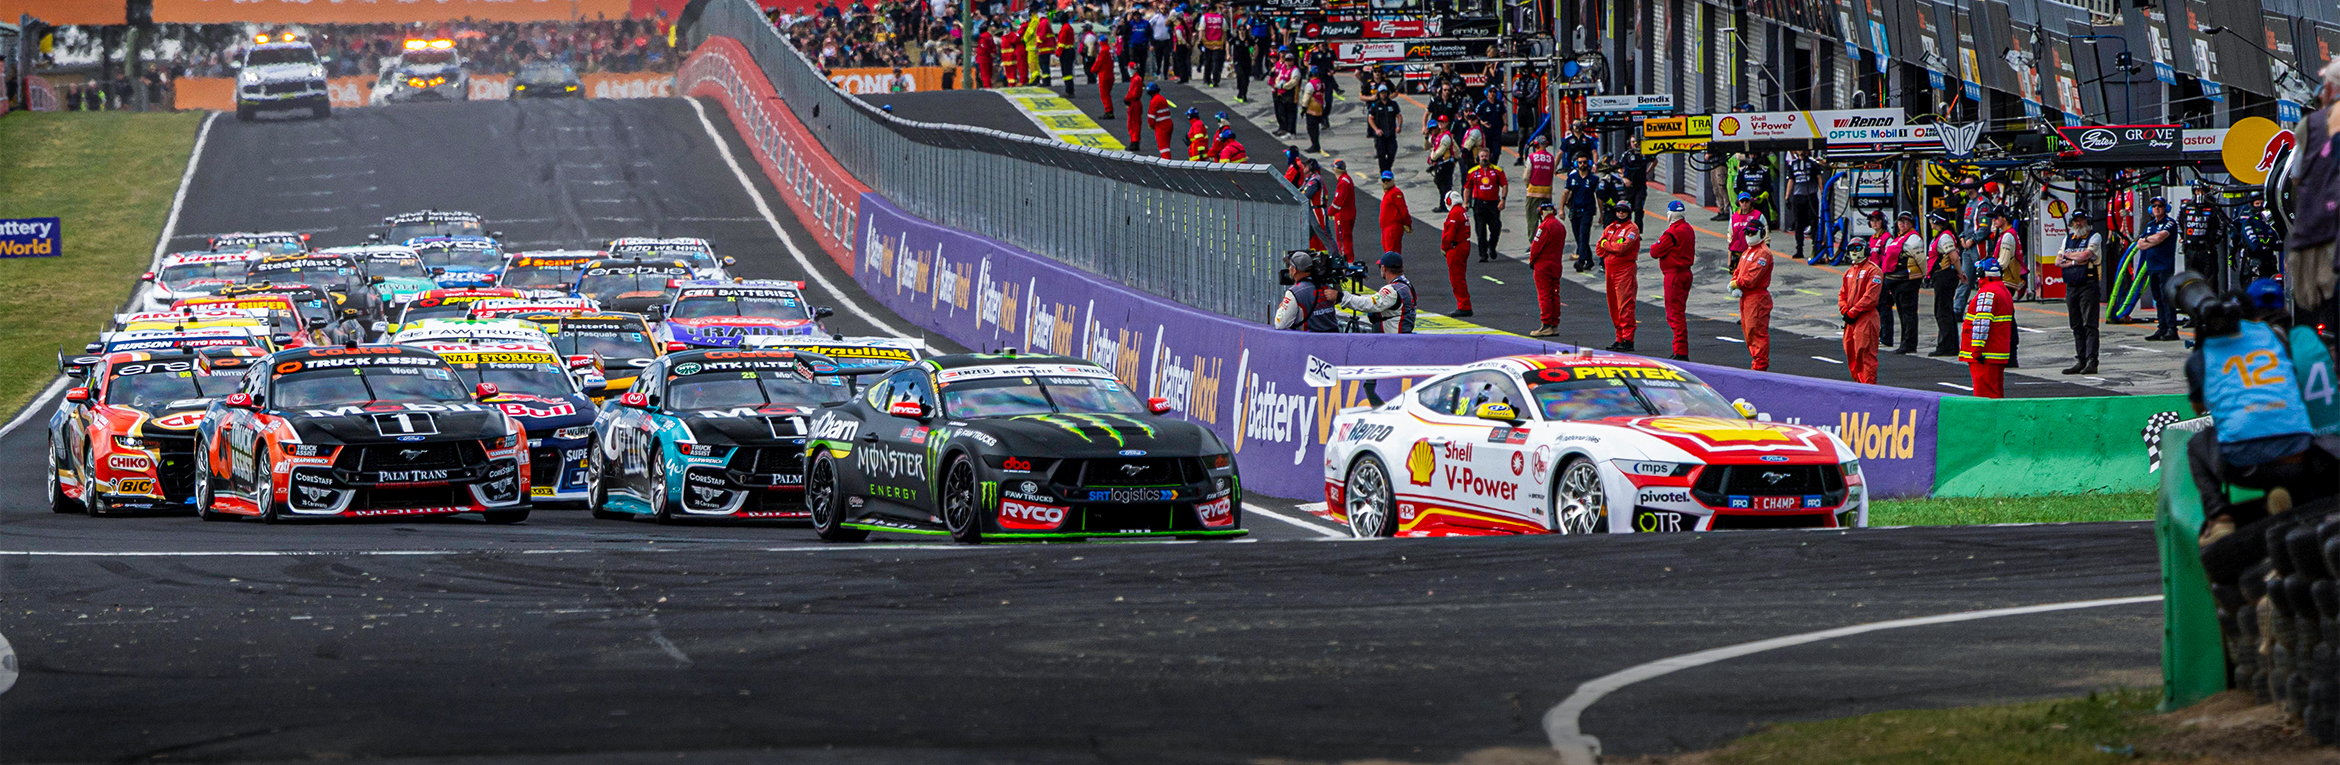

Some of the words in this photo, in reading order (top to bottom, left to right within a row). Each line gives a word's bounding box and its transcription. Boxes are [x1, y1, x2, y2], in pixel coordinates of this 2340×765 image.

[1321, 26, 1346, 36] Pizza
[1346, 26, 1361, 36] Hut
[1637, 96, 1670, 104] Bendix
[1750, 122, 1793, 131] V-Power
[1829, 130, 1867, 139] OPTUS
[1871, 129, 1897, 139] Mobil
[2125, 128, 2173, 141] GROVE
[2183, 135, 2216, 145] astrol
[1648, 142, 1677, 151] JAX
[1533, 153, 1552, 163] 283
[0, 221, 52, 239] attery
[0, 238, 52, 256] World
[718, 289, 796, 298] BATTERIES
[218, 302, 235, 310] IT
[237, 302, 287, 310] SUPER
[476, 329, 545, 339] TRUCKS
[112, 341, 174, 351] BURSON
[309, 346, 402, 357] Coates
[772, 345, 912, 358] ydraulink
[305, 357, 371, 369] TRUCK
[373, 356, 440, 367] ASSIST
[480, 353, 552, 363] STORAGE
[389, 367, 419, 375] Wood
[703, 361, 741, 371] NTK
[1310, 357, 1332, 380] DXC
[2223, 349, 2286, 388] 12
[434, 369, 449, 380] 4
[1573, 366, 1686, 382] PIRTEK
[1049, 377, 1090, 386] Waters
[1104, 379, 1120, 392] 2
[1160, 346, 1194, 422] Battery
[1191, 354, 1223, 424] World
[1641, 379, 1680, 388] Kostecki
[2303, 362, 2335, 406] 4
[305, 402, 483, 418] Mobil
[892, 406, 922, 414] RYCO
[1455, 396, 1471, 416] 38
[391, 413, 415, 433] 1
[785, 416, 808, 435] 1
[1247, 372, 1318, 466] Battery
[1349, 418, 1394, 443] Repco
[1841, 408, 1917, 460] World
[973, 431, 998, 447] TRUCKS
[1445, 441, 1473, 463] Shell
[110, 457, 148, 468] CHIKO
[1003, 456, 1031, 471] dba
[1641, 463, 1668, 474] mps
[378, 470, 409, 482] PALM
[411, 469, 448, 482] TRANS
[772, 473, 803, 485] PALM
[1444, 464, 1518, 501] V-Power
[869, 483, 917, 500] ENERGY
[1005, 490, 1025, 499] FAW
[1024, 493, 1054, 503] TRUCKS
[1640, 490, 1691, 505] pivotel.
[1199, 499, 1231, 519] RYCO
[1733, 500, 1748, 508] PPQ
[1763, 497, 1795, 510] CH4MP
[1002, 502, 1064, 522] RYCO
